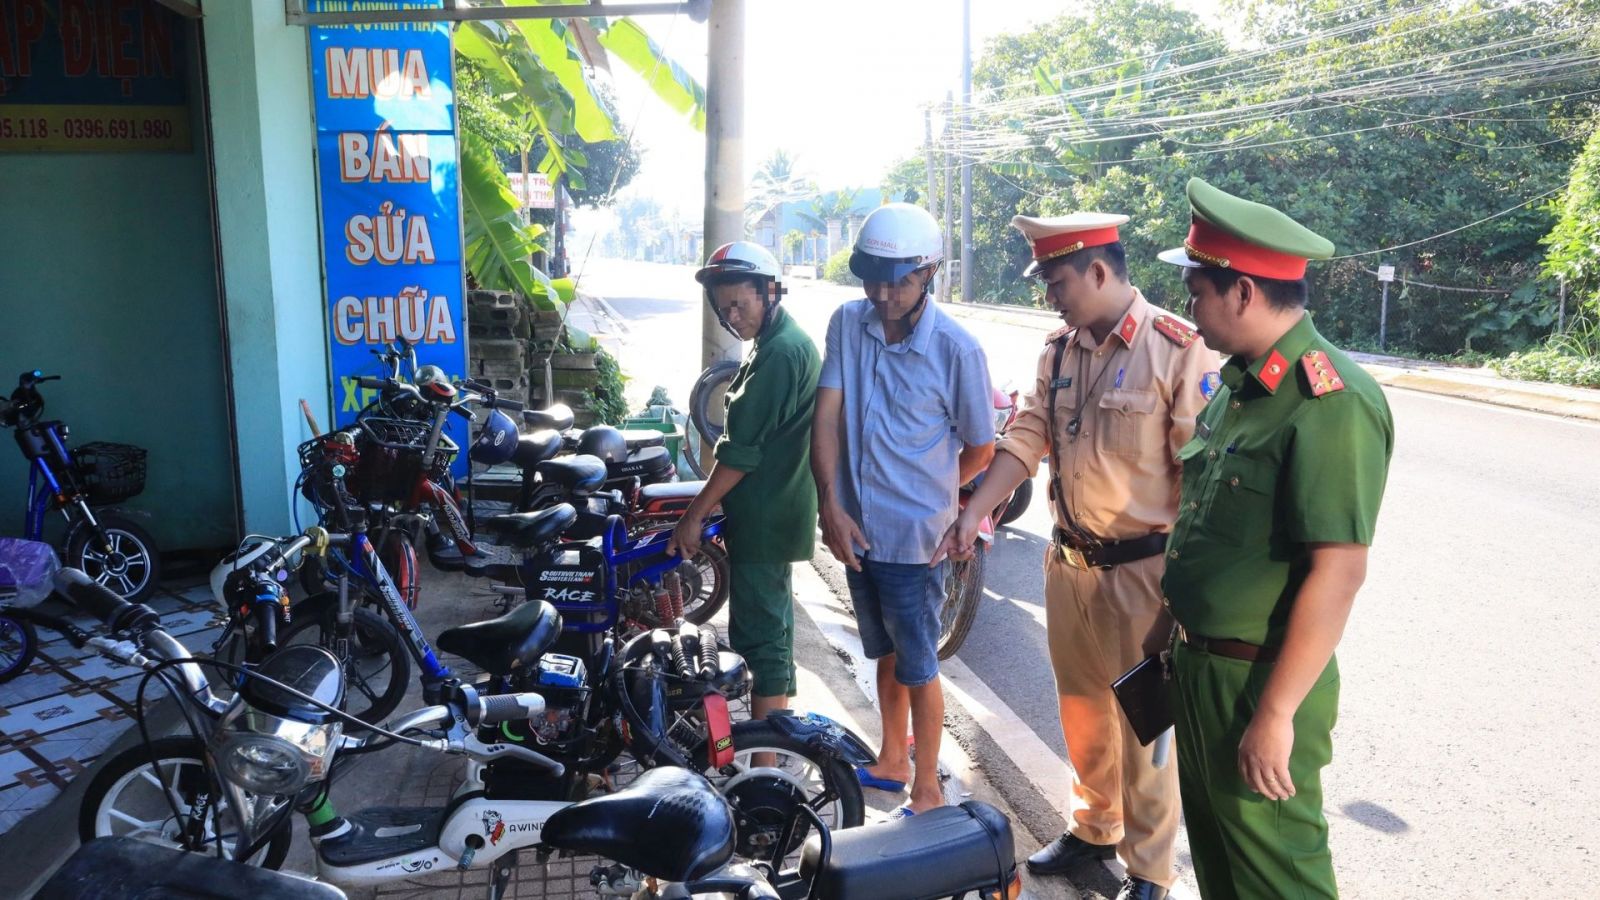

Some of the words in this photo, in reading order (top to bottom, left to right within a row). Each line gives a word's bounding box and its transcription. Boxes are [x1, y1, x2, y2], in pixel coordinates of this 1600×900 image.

[325, 47, 432, 99] MUA
[0, 118, 48, 139] 5.118
[64, 118, 172, 139] 0396.691.980
[338, 119, 430, 182] BÁN
[345, 200, 436, 265] SỬA
[333, 285, 456, 345] CHỮA
[542, 587, 596, 602] RACE
